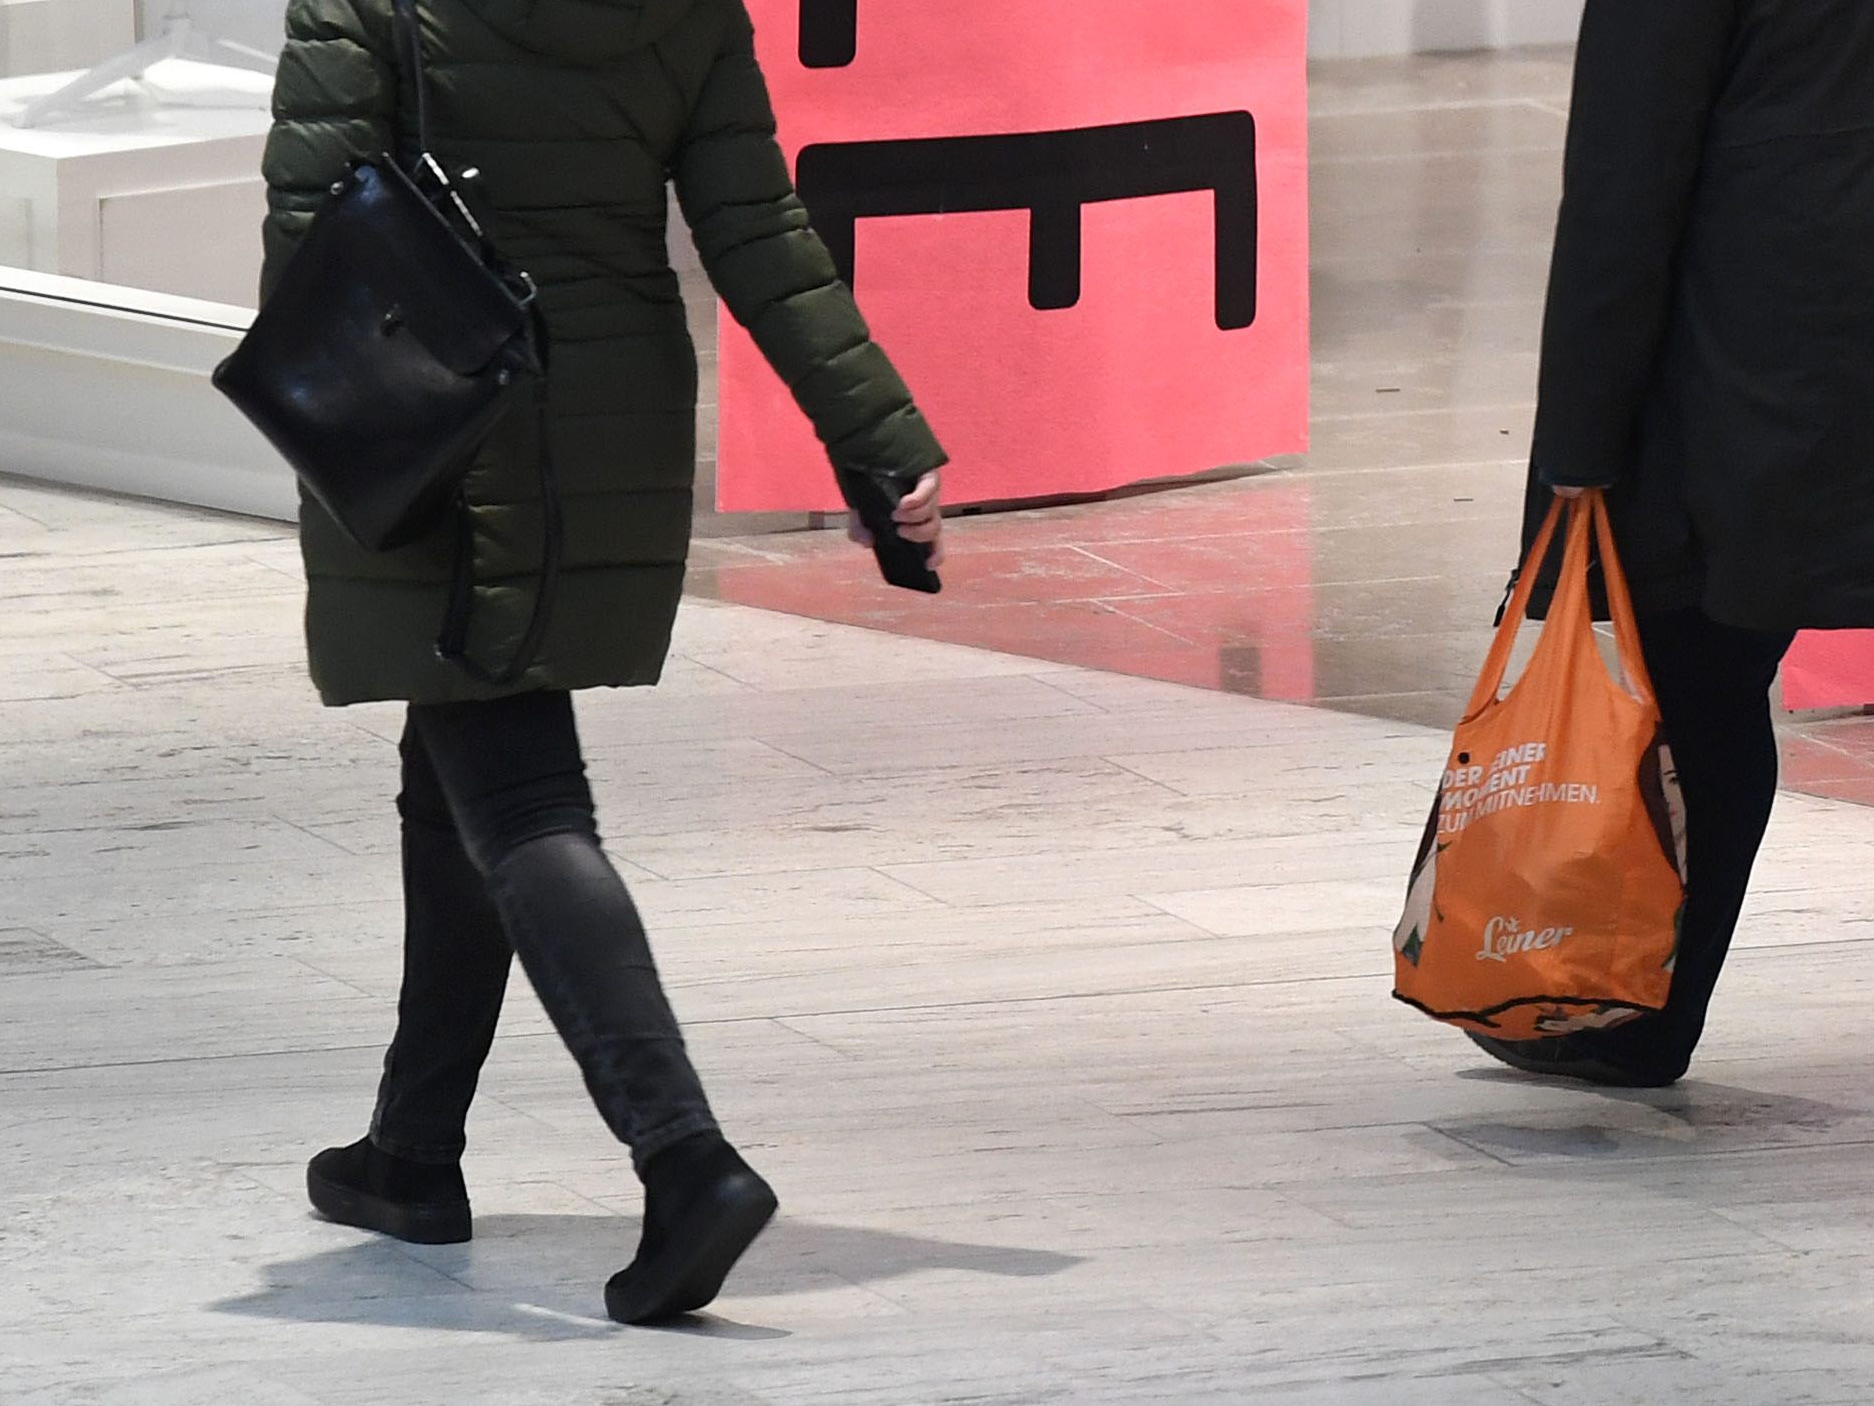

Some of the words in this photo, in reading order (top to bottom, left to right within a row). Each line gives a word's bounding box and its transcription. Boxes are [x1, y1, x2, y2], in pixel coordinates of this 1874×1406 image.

[1439, 764, 1532, 812] MOENT
[1441, 765, 1484, 789] DER
[1475, 913, 1574, 963] Leiner
